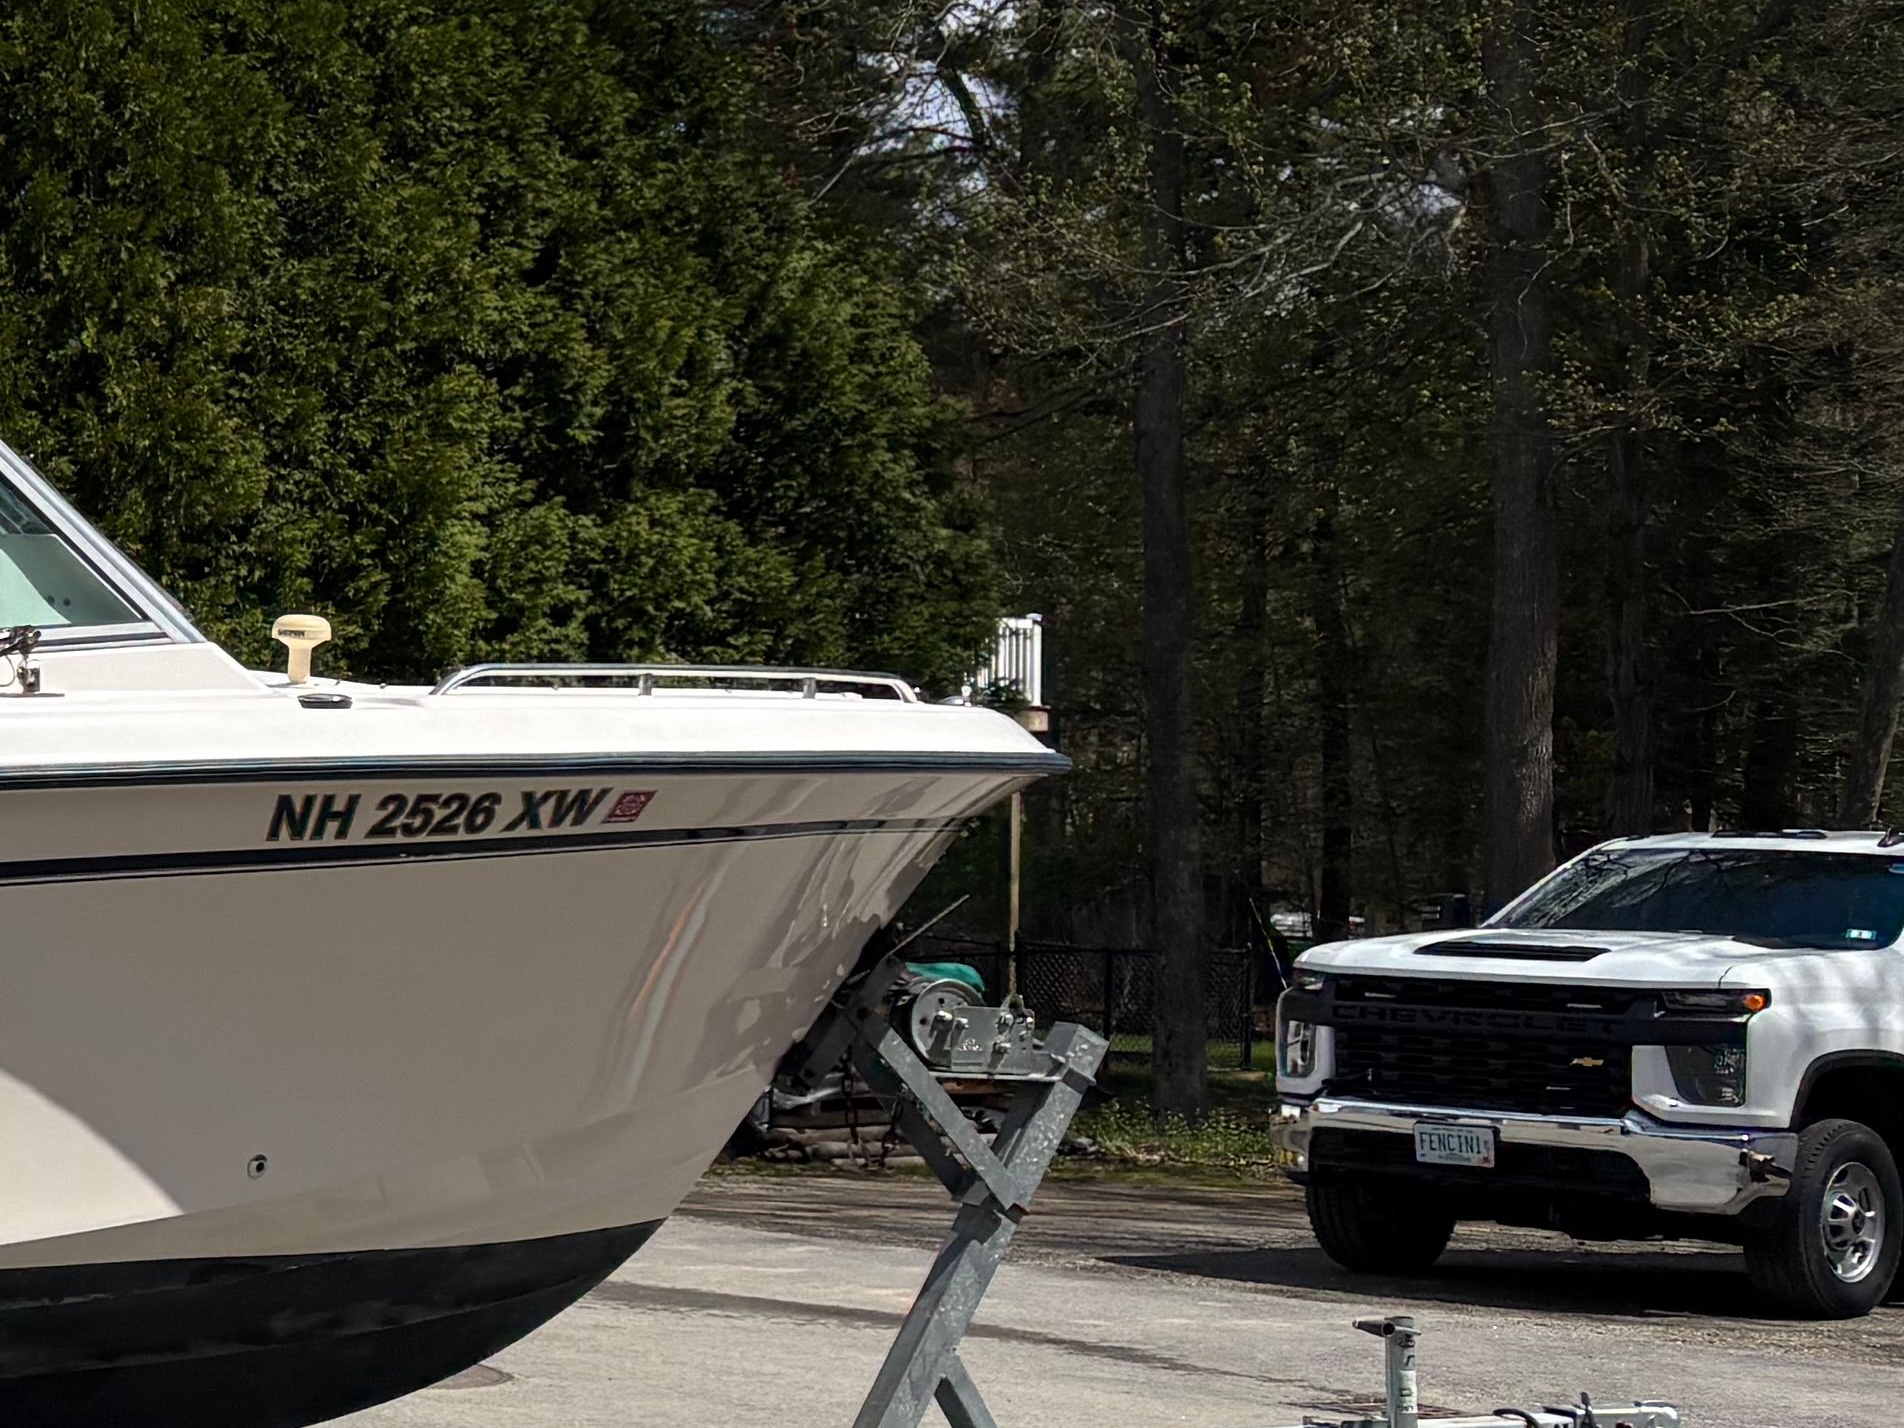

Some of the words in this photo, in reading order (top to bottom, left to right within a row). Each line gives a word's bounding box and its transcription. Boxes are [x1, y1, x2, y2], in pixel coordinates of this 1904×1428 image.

[265, 793, 362, 842] NH
[364, 792, 503, 839] 2526
[499, 787, 615, 833] XW
